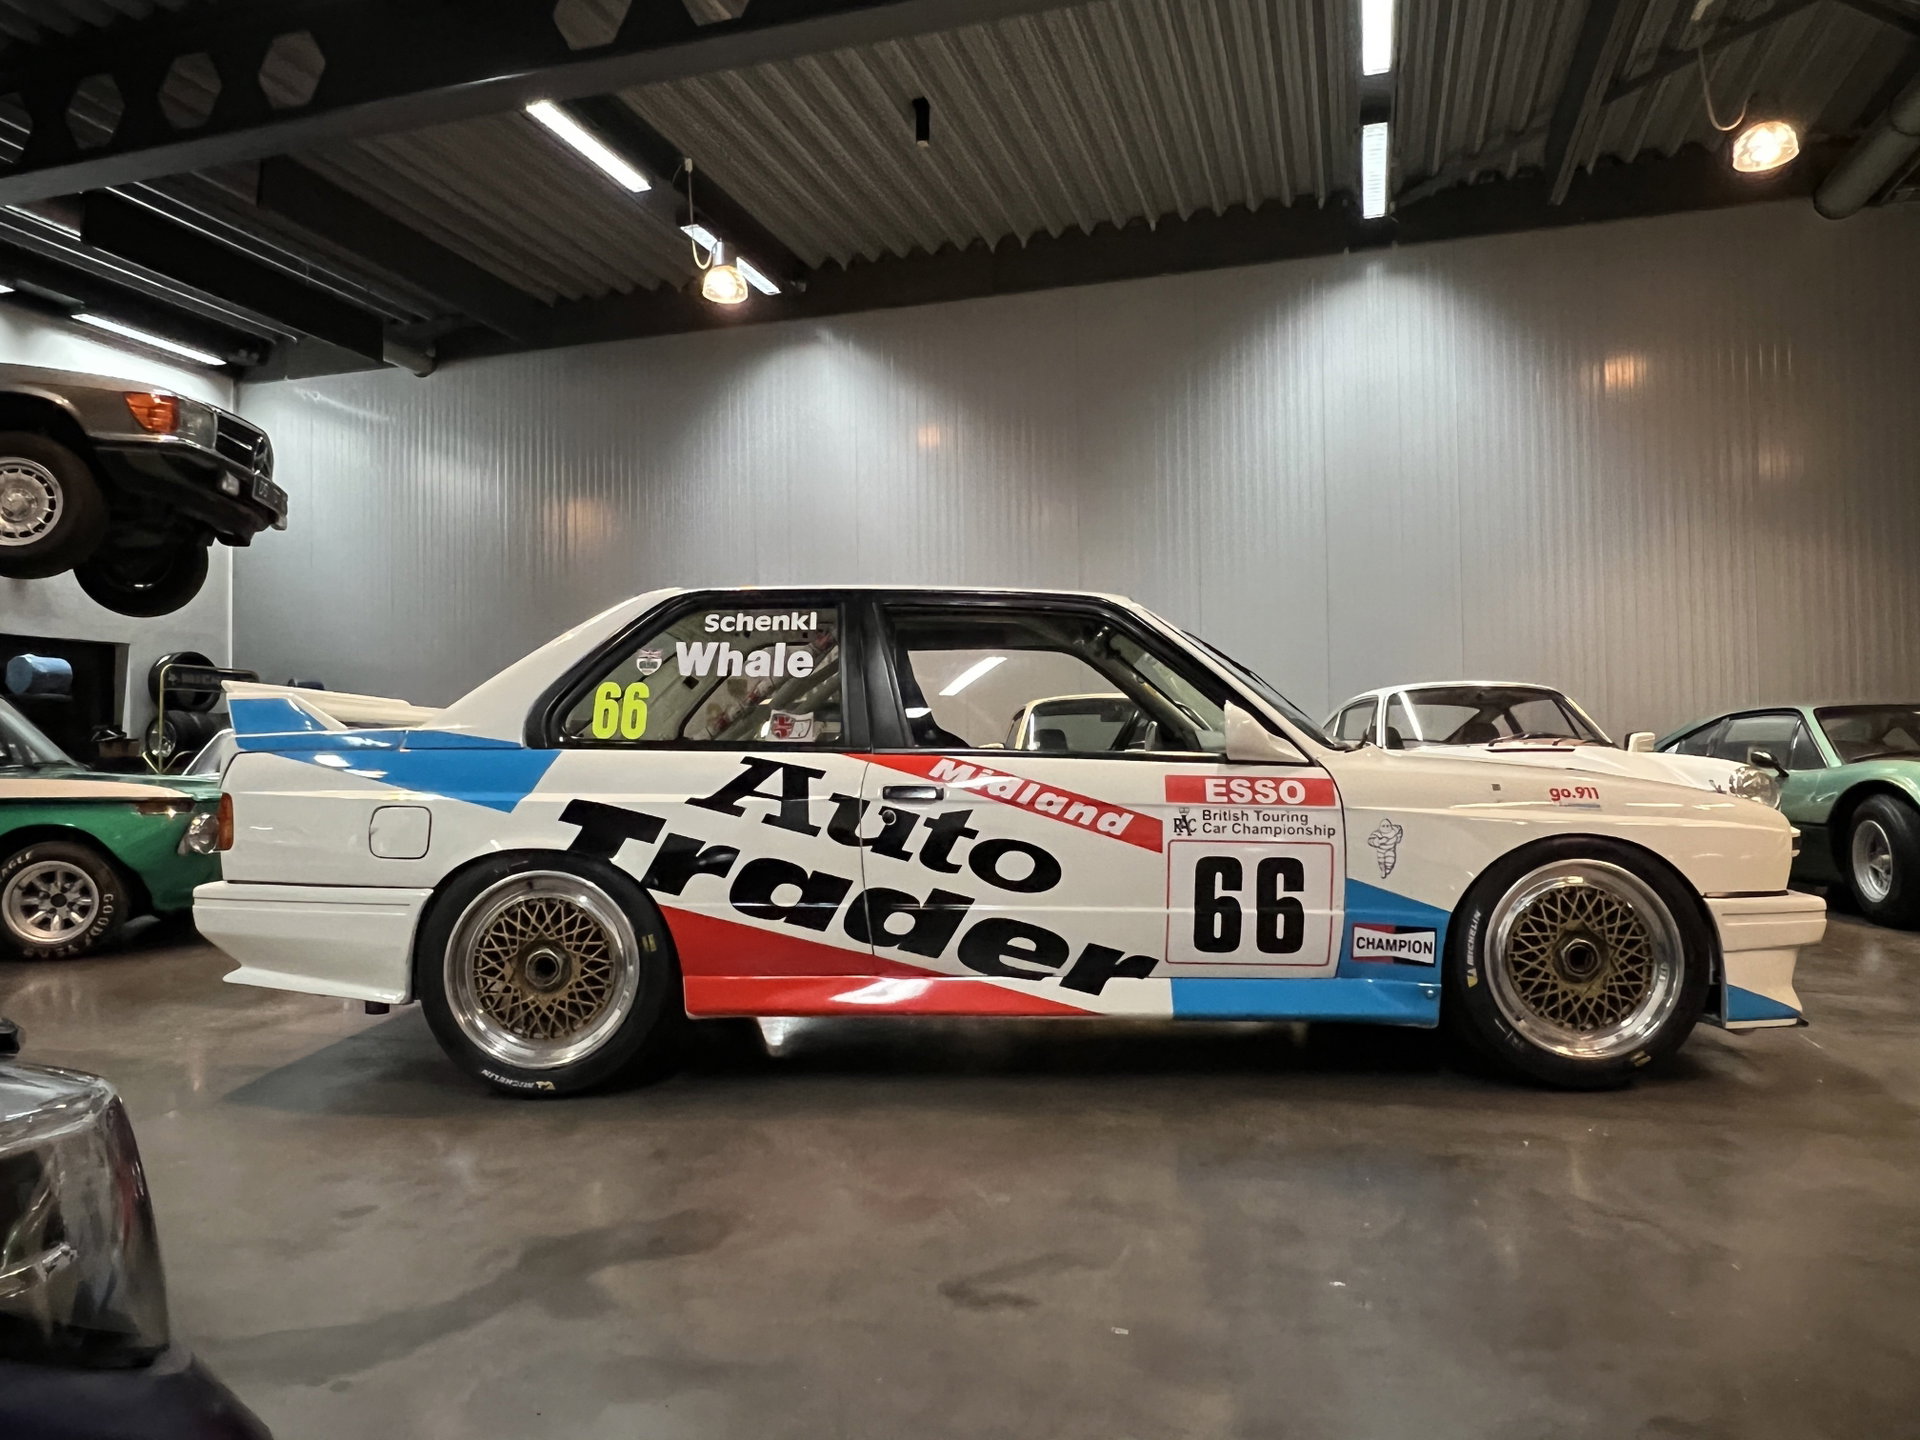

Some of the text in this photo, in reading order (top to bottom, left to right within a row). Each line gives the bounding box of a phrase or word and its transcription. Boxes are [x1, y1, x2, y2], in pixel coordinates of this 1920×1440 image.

[704, 611, 818, 633] Schenkl
[675, 642, 815, 678] Whale
[592, 681, 650, 740] 66
[929, 758, 1135, 836] Midland
[1205, 779, 1306, 805] ESSO
[1549, 786, 1600, 801] go.911
[684, 756, 1062, 893] Auto
[1202, 810, 1309, 825] British Touring
[1202, 823, 1336, 839] Car Championship
[558, 798, 1160, 997] Trader
[1193, 855, 1305, 954] 66
[1356, 936, 1433, 955] CHAMPION
[1466, 909, 1482, 966] MICHELIN
